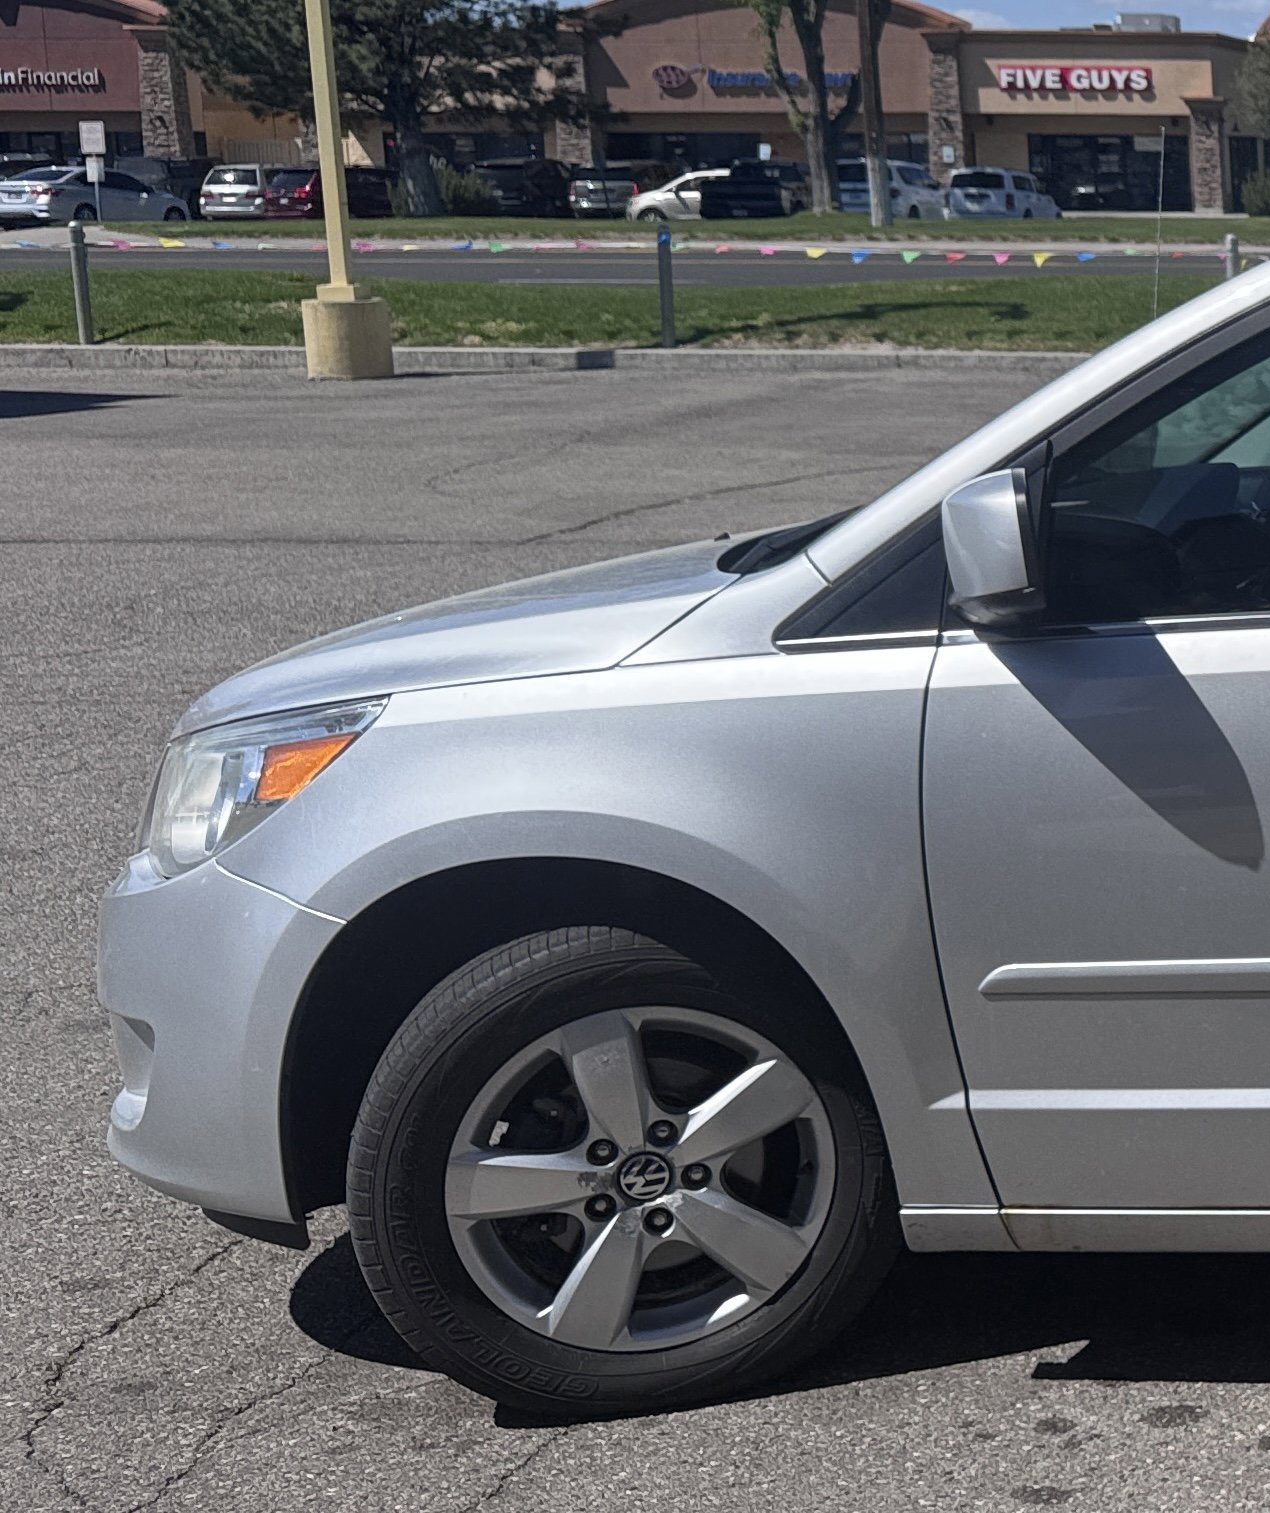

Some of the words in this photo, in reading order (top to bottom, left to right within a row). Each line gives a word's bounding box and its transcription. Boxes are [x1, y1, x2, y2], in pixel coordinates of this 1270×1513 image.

[18, 67, 99, 85] Financial
[707, 68, 798, 87] Insurae
[1000, 68, 1063, 89] FIVE
[1070, 69, 1149, 90] GUYS
[387, 1183, 601, 1399] GEOLANDAR
